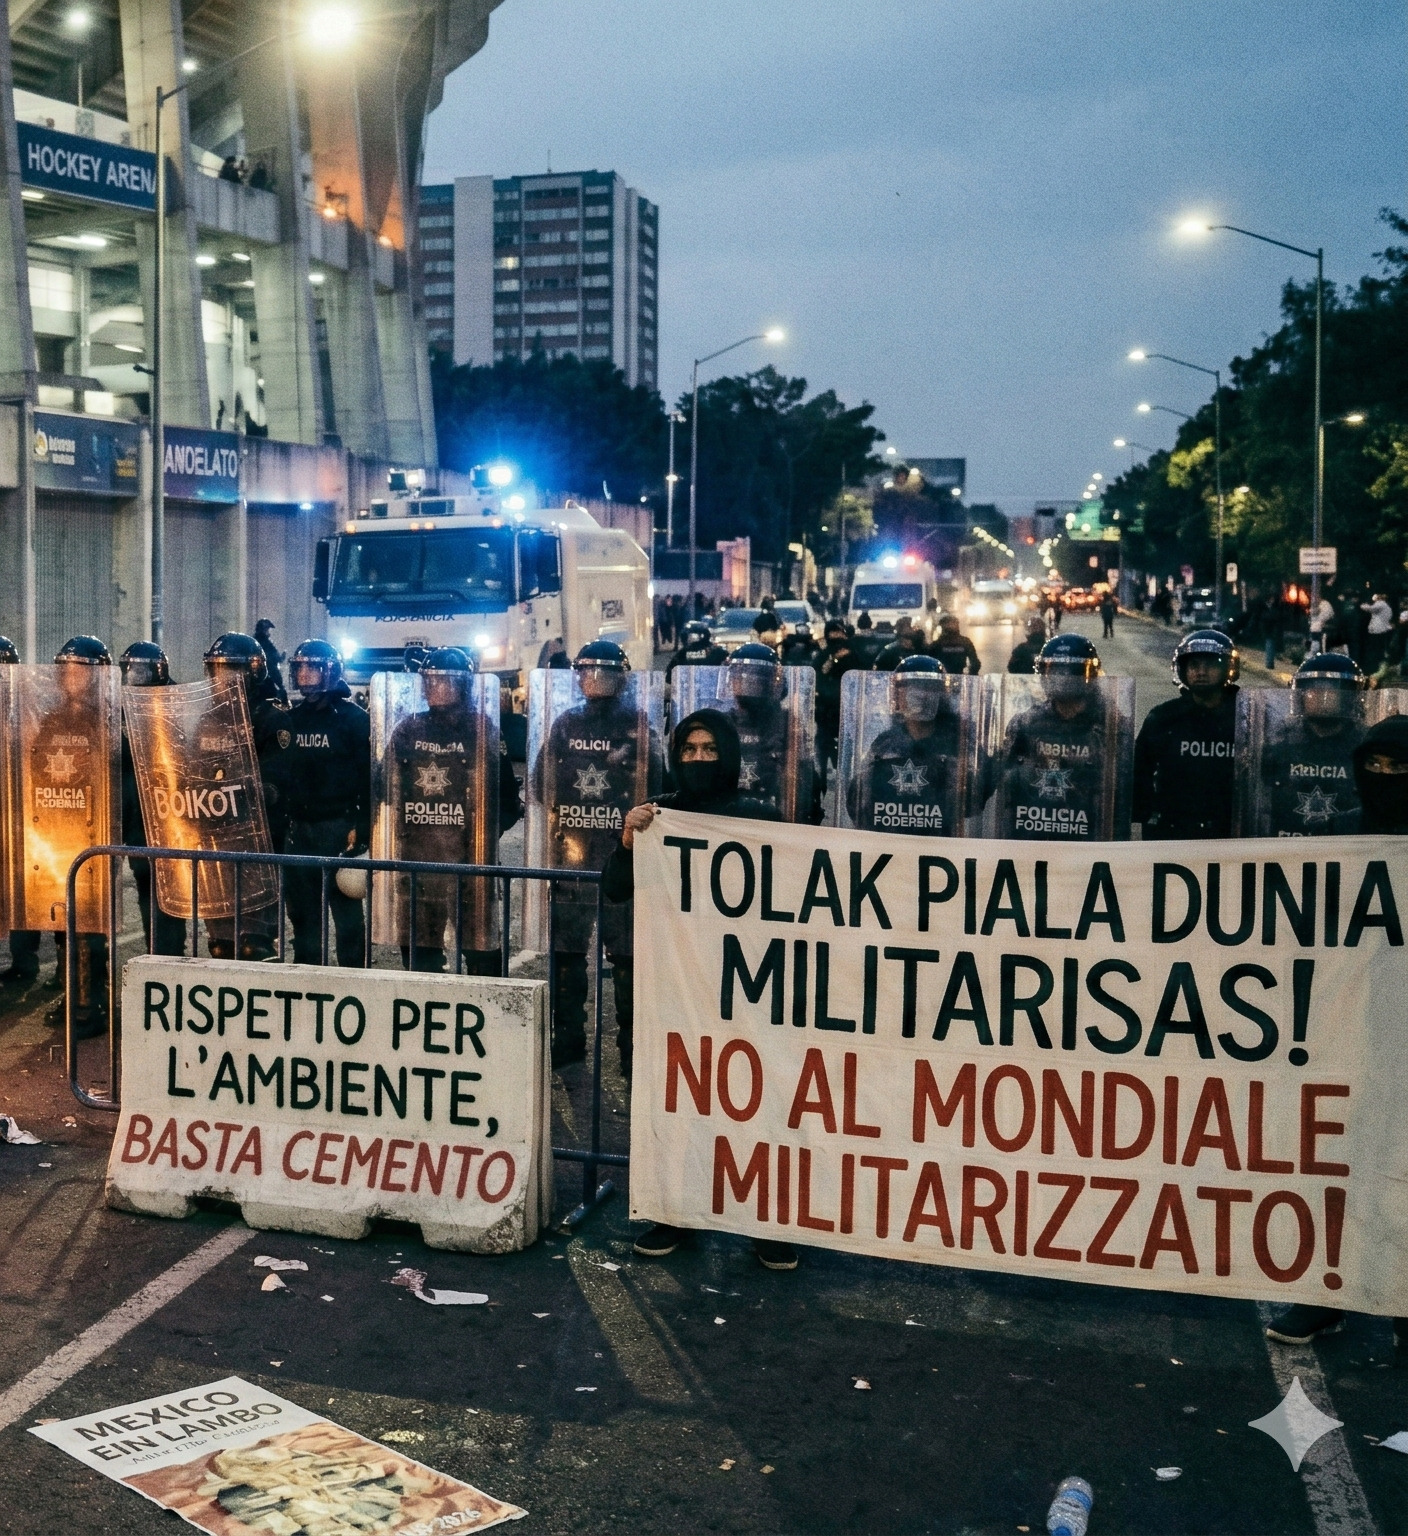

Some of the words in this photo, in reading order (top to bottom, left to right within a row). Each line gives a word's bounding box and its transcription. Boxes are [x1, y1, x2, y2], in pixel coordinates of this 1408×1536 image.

[28, 142, 102, 183] HOCKEY
[35, 787, 85, 799] POLICIA
[405, 802, 465, 816] POLICIA
[559, 805, 622, 819] POLICIA
[874, 802, 943, 817] POLICIA
[1016, 805, 1089, 823] POLICIA
[663, 835, 893, 929] TOLAK
[917, 854, 1126, 943] PIALA
[1150, 860, 1405, 948] DUNIA
[144, 981, 367, 1046] RISPETTO
[392, 998, 487, 1059] PER
[719, 933, 1317, 1067] MILITARISAS!
[167, 1045, 500, 1138] L'AMBIENTE,
[664, 1031, 764, 1122] NO
[787, 1047, 882, 1139] AL
[911, 1058, 1351, 1178] MONDIALE
[121, 1113, 263, 1176] BASTA
[282, 1130, 517, 1204] CEMENTO
[711, 1135, 1347, 1292] MILITARIZZATO!
[73, 1391, 240, 1442] MEXICO
[87, 1435, 159, 1461] EIN
[155, 1402, 283, 1442] LAMBO
